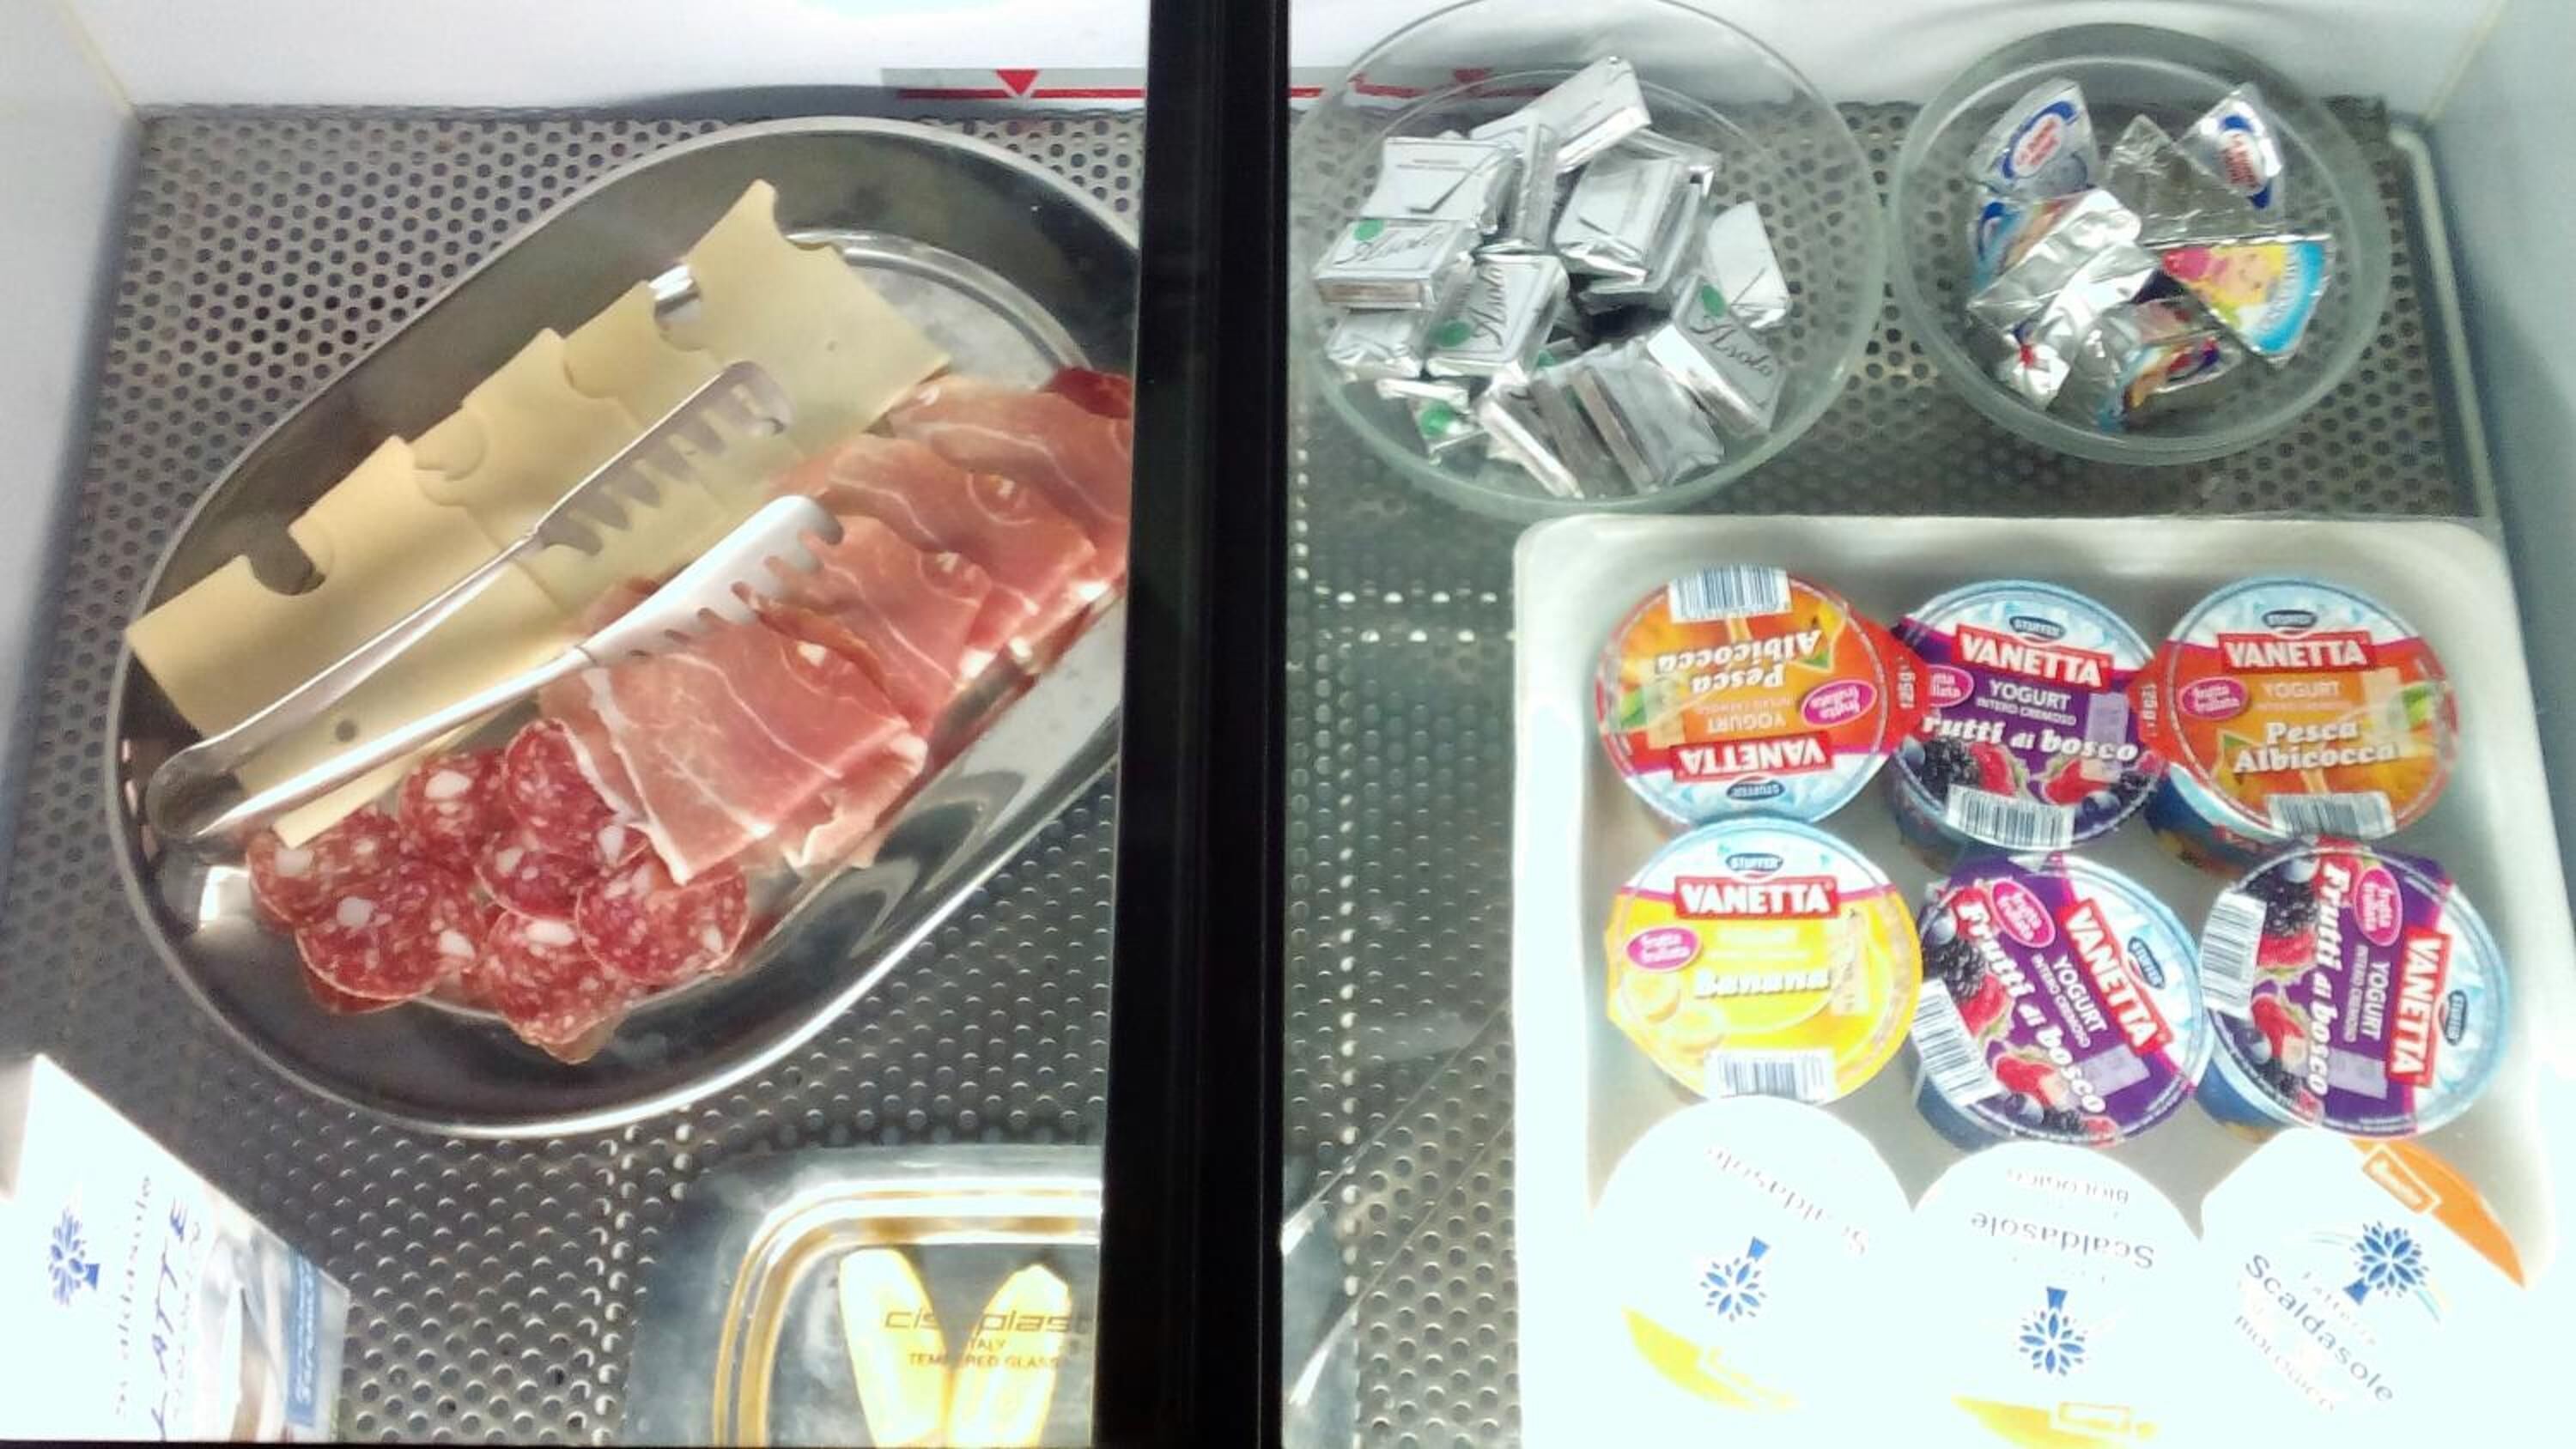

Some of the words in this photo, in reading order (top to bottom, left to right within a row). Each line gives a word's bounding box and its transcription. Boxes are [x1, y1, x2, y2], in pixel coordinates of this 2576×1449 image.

[1655, 628, 1823, 676] Albicocca
[1958, 632, 2104, 688] VANETTA
[2223, 638, 2368, 668] VANETTA
[1691, 664, 1788, 694] Pesca
[1988, 678, 2072, 712] YOGURT
[2263, 680, 2342, 699] YOGURT
[1705, 712, 1788, 735] YOGURT
[1921, 714, 2006, 744] rutti
[2010, 731, 2035, 749] di
[2039, 728, 2139, 762] bosco
[2265, 720, 2360, 745] Pesca
[1680, 737, 1826, 774] VANETTA
[2233, 742, 2399, 774] Albicocca
[1679, 884, 1832, 915] VANETTA
[2318, 862, 2352, 972] Frutti
[1694, 969, 1832, 999] Banana
[2051, 954, 2109, 1033] YOGURT
[2065, 906, 2160, 1048] VANETTA
[2312, 972, 2333, 999] di
[2360, 961, 2391, 1041] YOGURT
[1957, 903, 2036, 997] Frutti
[2018, 1003, 2047, 1028] di
[2036, 1025, 2106, 1113] bosco
[2390, 938, 2443, 1075] VANETTA
[2306, 1000, 2338, 1097] bosco
[1971, 1211, 2155, 1270] Scaldasole
[149, 1197, 190, 1442] LATTE
[2245, 1253, 2395, 1404] Scaldasole
